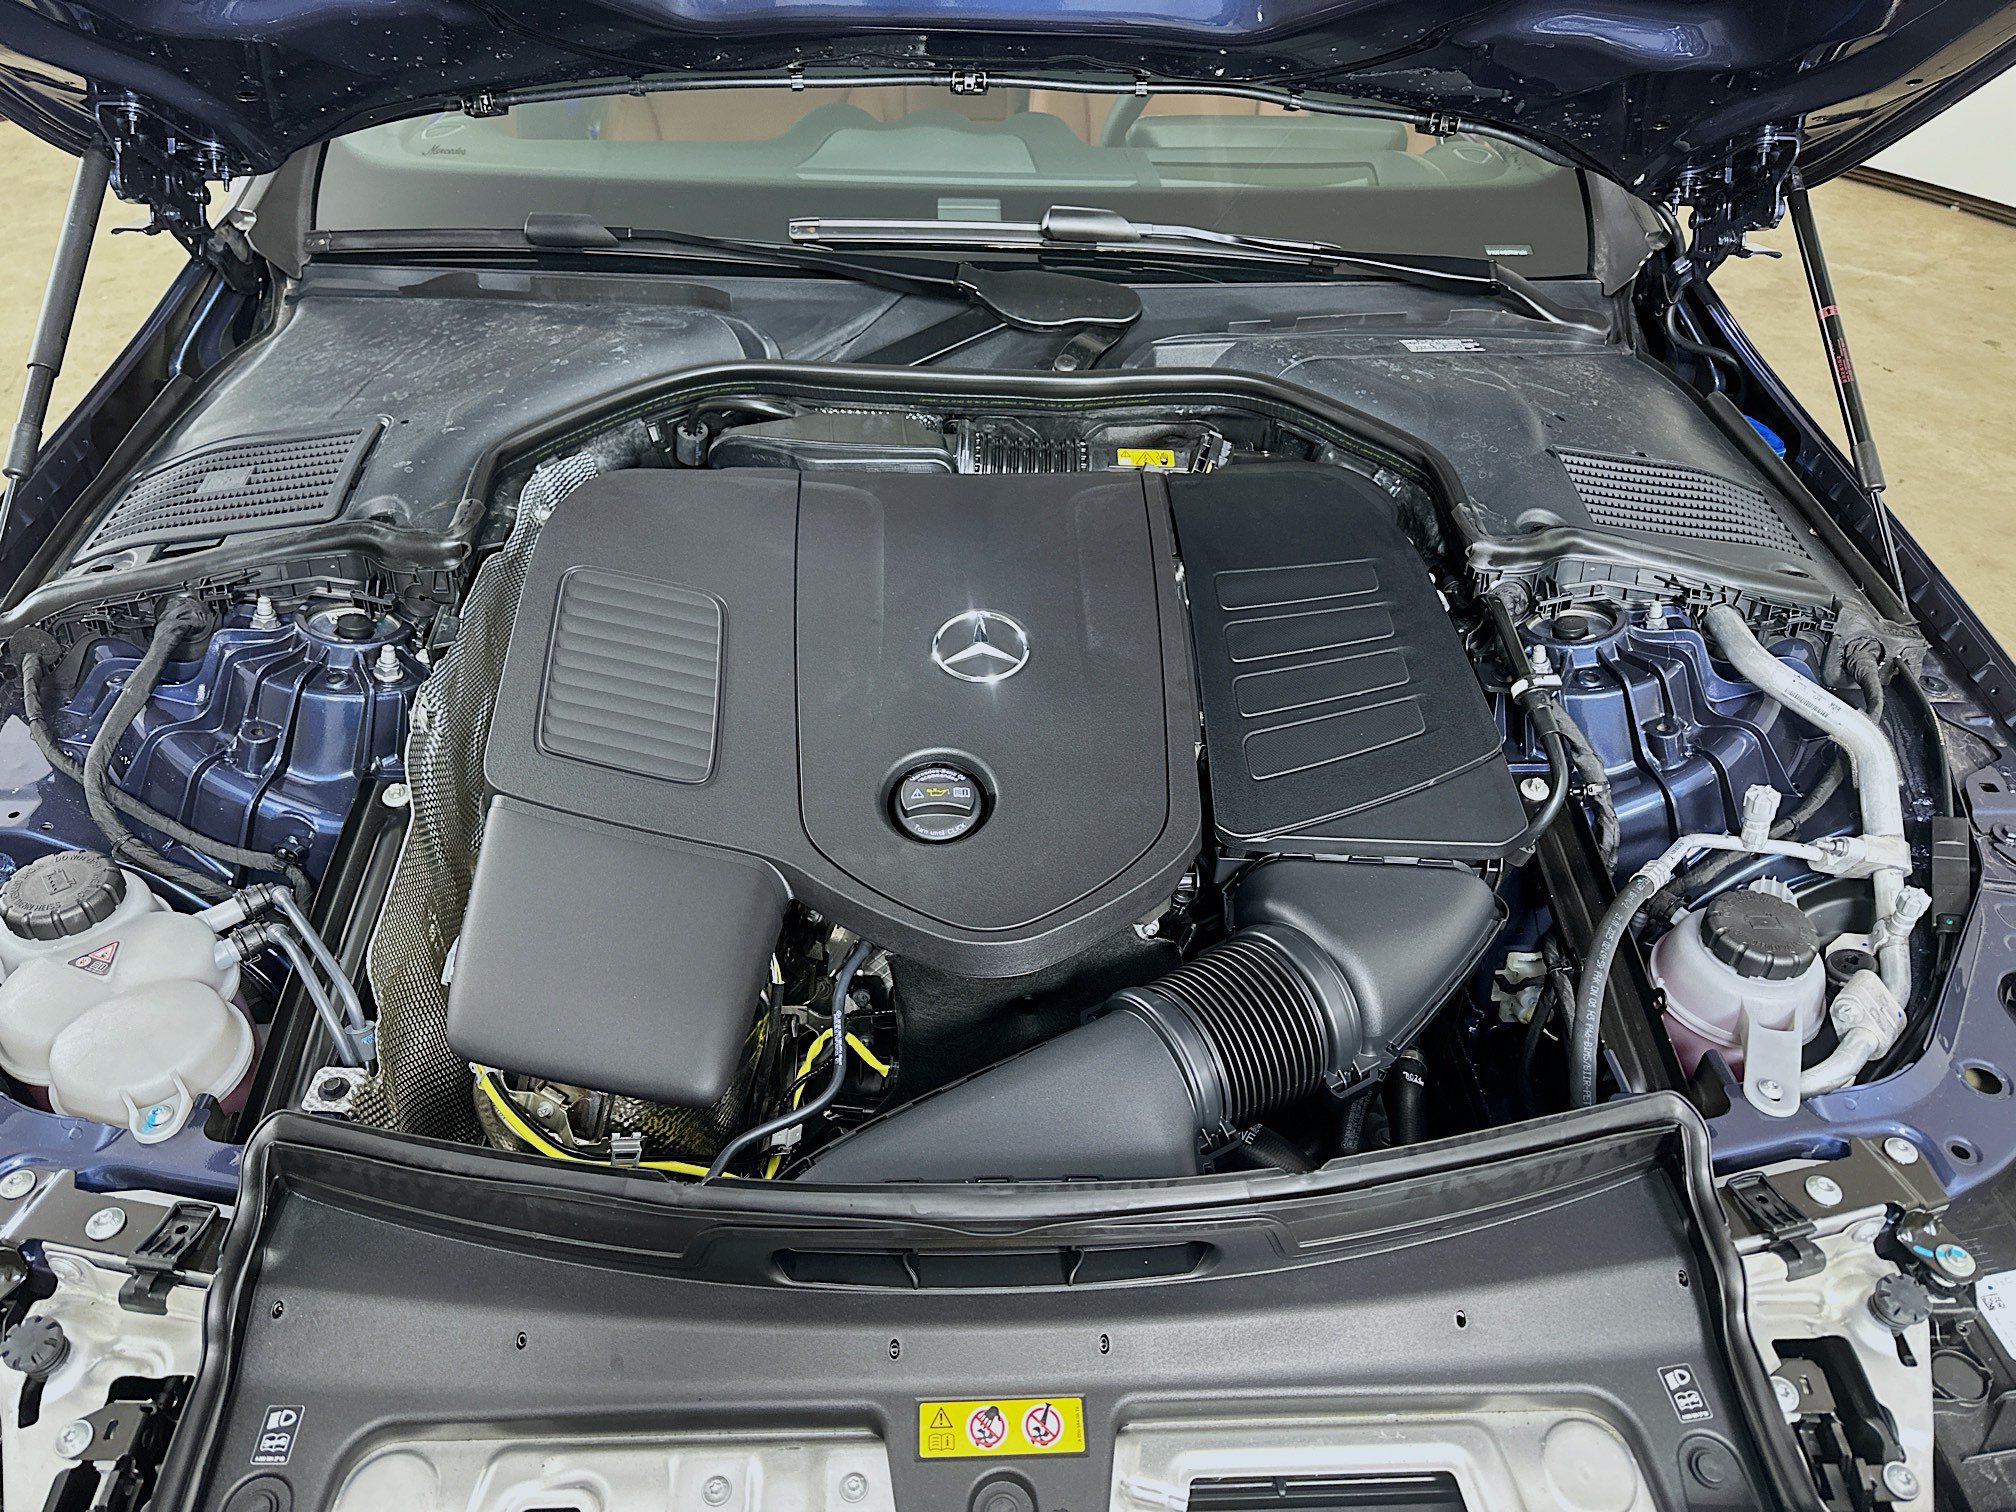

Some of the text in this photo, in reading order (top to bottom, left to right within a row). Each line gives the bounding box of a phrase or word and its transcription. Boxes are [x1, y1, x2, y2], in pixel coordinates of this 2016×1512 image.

[914, 822, 967, 836] Turn until CLICK
